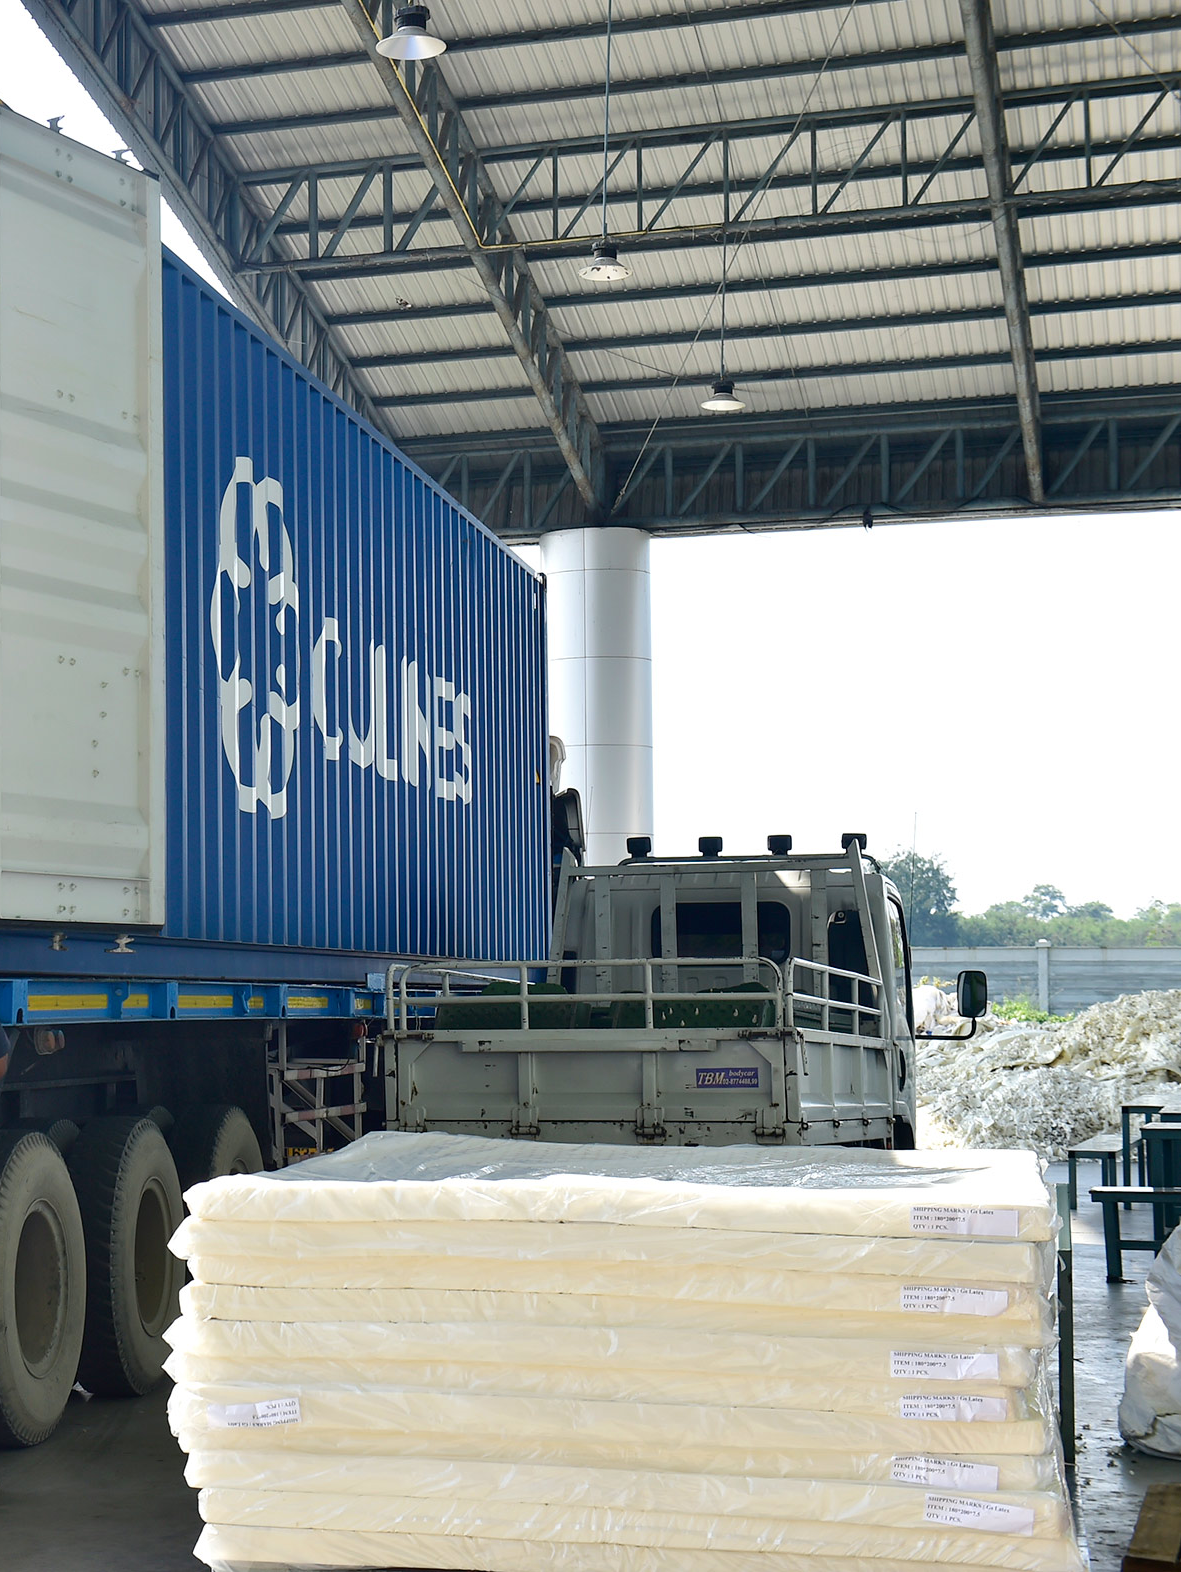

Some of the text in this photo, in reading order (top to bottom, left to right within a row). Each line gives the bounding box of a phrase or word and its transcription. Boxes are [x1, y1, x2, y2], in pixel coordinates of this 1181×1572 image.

[698, 1072, 725, 1085] TBM
[924, 1458, 946, 1466] MARKS
[928, 1496, 957, 1505] SHIPPING
[959, 1499, 982, 1508] MARKS
